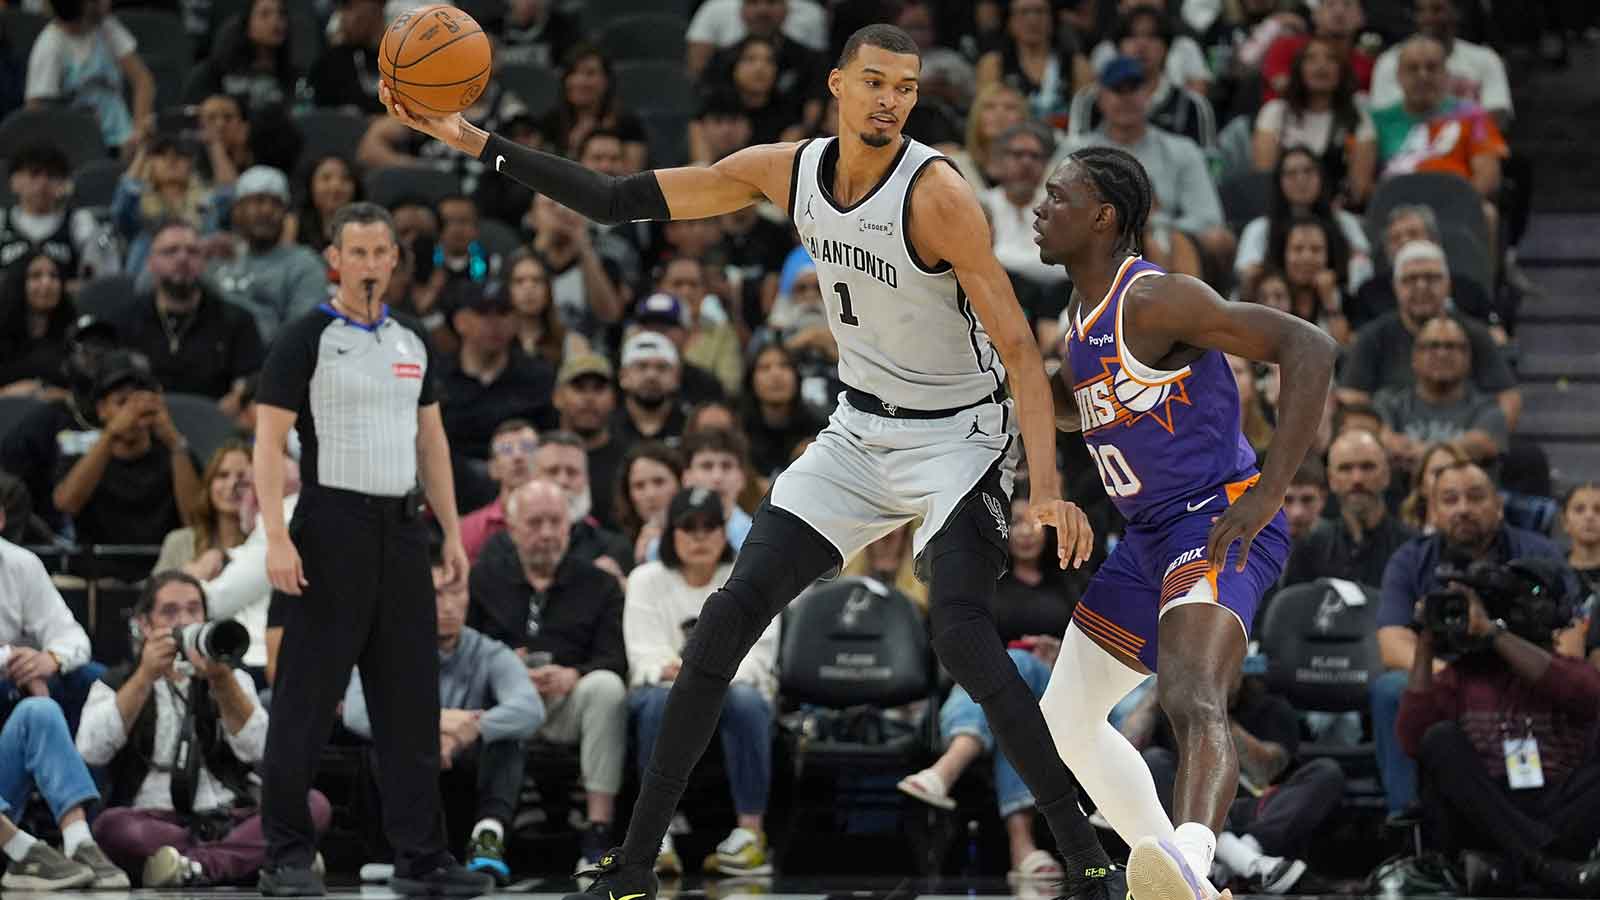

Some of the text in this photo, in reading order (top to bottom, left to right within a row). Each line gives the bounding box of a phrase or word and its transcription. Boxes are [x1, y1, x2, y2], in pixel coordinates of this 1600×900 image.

[863, 223, 888, 232] LEDGER
[822, 239, 898, 289] ANTONIO
[832, 281, 860, 327] 1
[1089, 334, 1114, 347] PayPal
